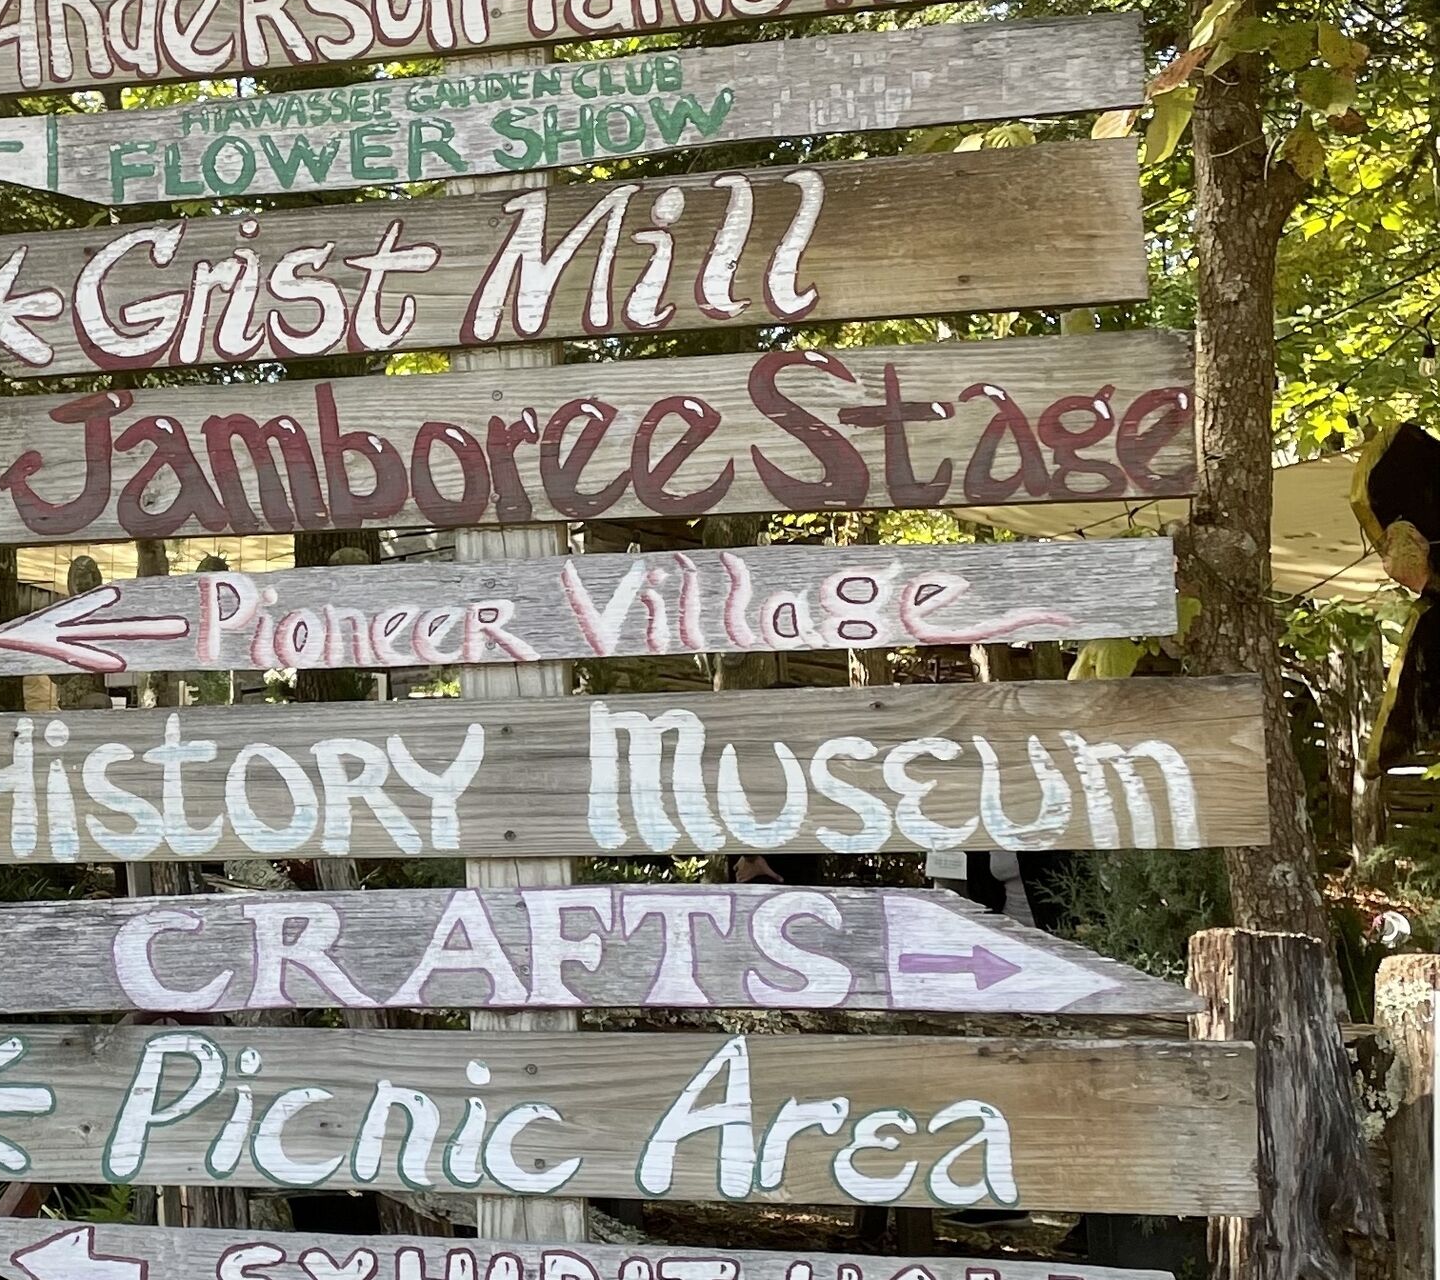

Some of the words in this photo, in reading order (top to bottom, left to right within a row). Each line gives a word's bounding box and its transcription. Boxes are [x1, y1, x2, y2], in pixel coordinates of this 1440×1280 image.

[108, 117, 468, 204] FLOWER
[492, 86, 735, 171] SHOW
[182, 84, 393, 135] HIAWASSEE
[406, 64, 563, 112] GARDEN
[571, 54, 684, 99] CLUB
[71, 219, 442, 371] Grist
[459, 168, 826, 344] Mill
[748, 349, 1196, 511] Stage
[560, 551, 1076, 657] Village
[112, 886, 858, 1011] CRAFTS
[101, 1029, 584, 1196] Picnic
[634, 1033, 1021, 1209] Area
